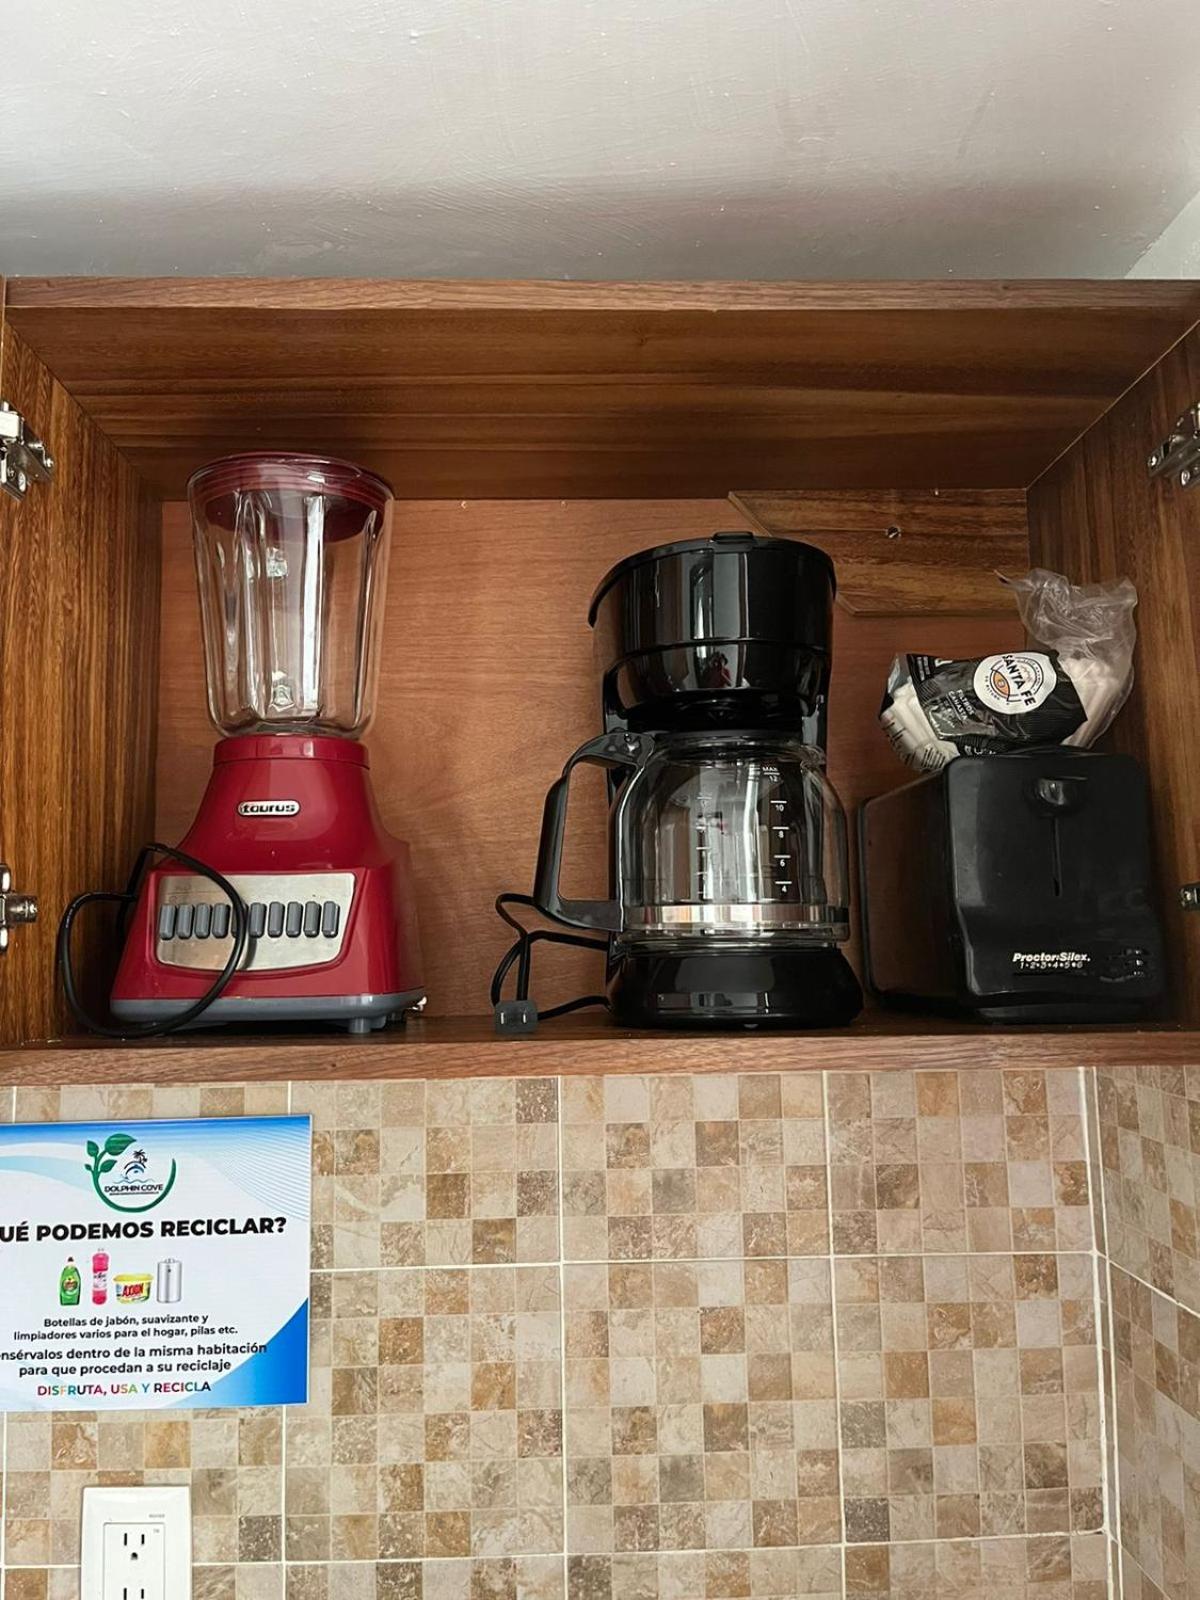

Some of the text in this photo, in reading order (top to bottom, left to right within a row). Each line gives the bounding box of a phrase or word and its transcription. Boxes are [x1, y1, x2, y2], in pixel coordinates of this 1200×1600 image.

[1020, 690, 1036, 706] FE
[242, 804, 295, 813] taurus
[104, 1185, 140, 1193] DOLPHIN
[36, 1221, 154, 1241] PODEMOS
[160, 1217, 287, 1237] RECICLAR?
[44, 1314, 209, 1328] Botellas de jabón, suavizante y
[14, 1326, 238, 1341] limpiadores varios para el hogar, pilas etc.
[0, 1342, 268, 1361] nsérvalos dentro de la misma habitación
[19, 1360, 231, 1377] para que procedan a su reciclaje
[37, 1381, 212, 1396] DISFRUTA, USA Y RECICLA
